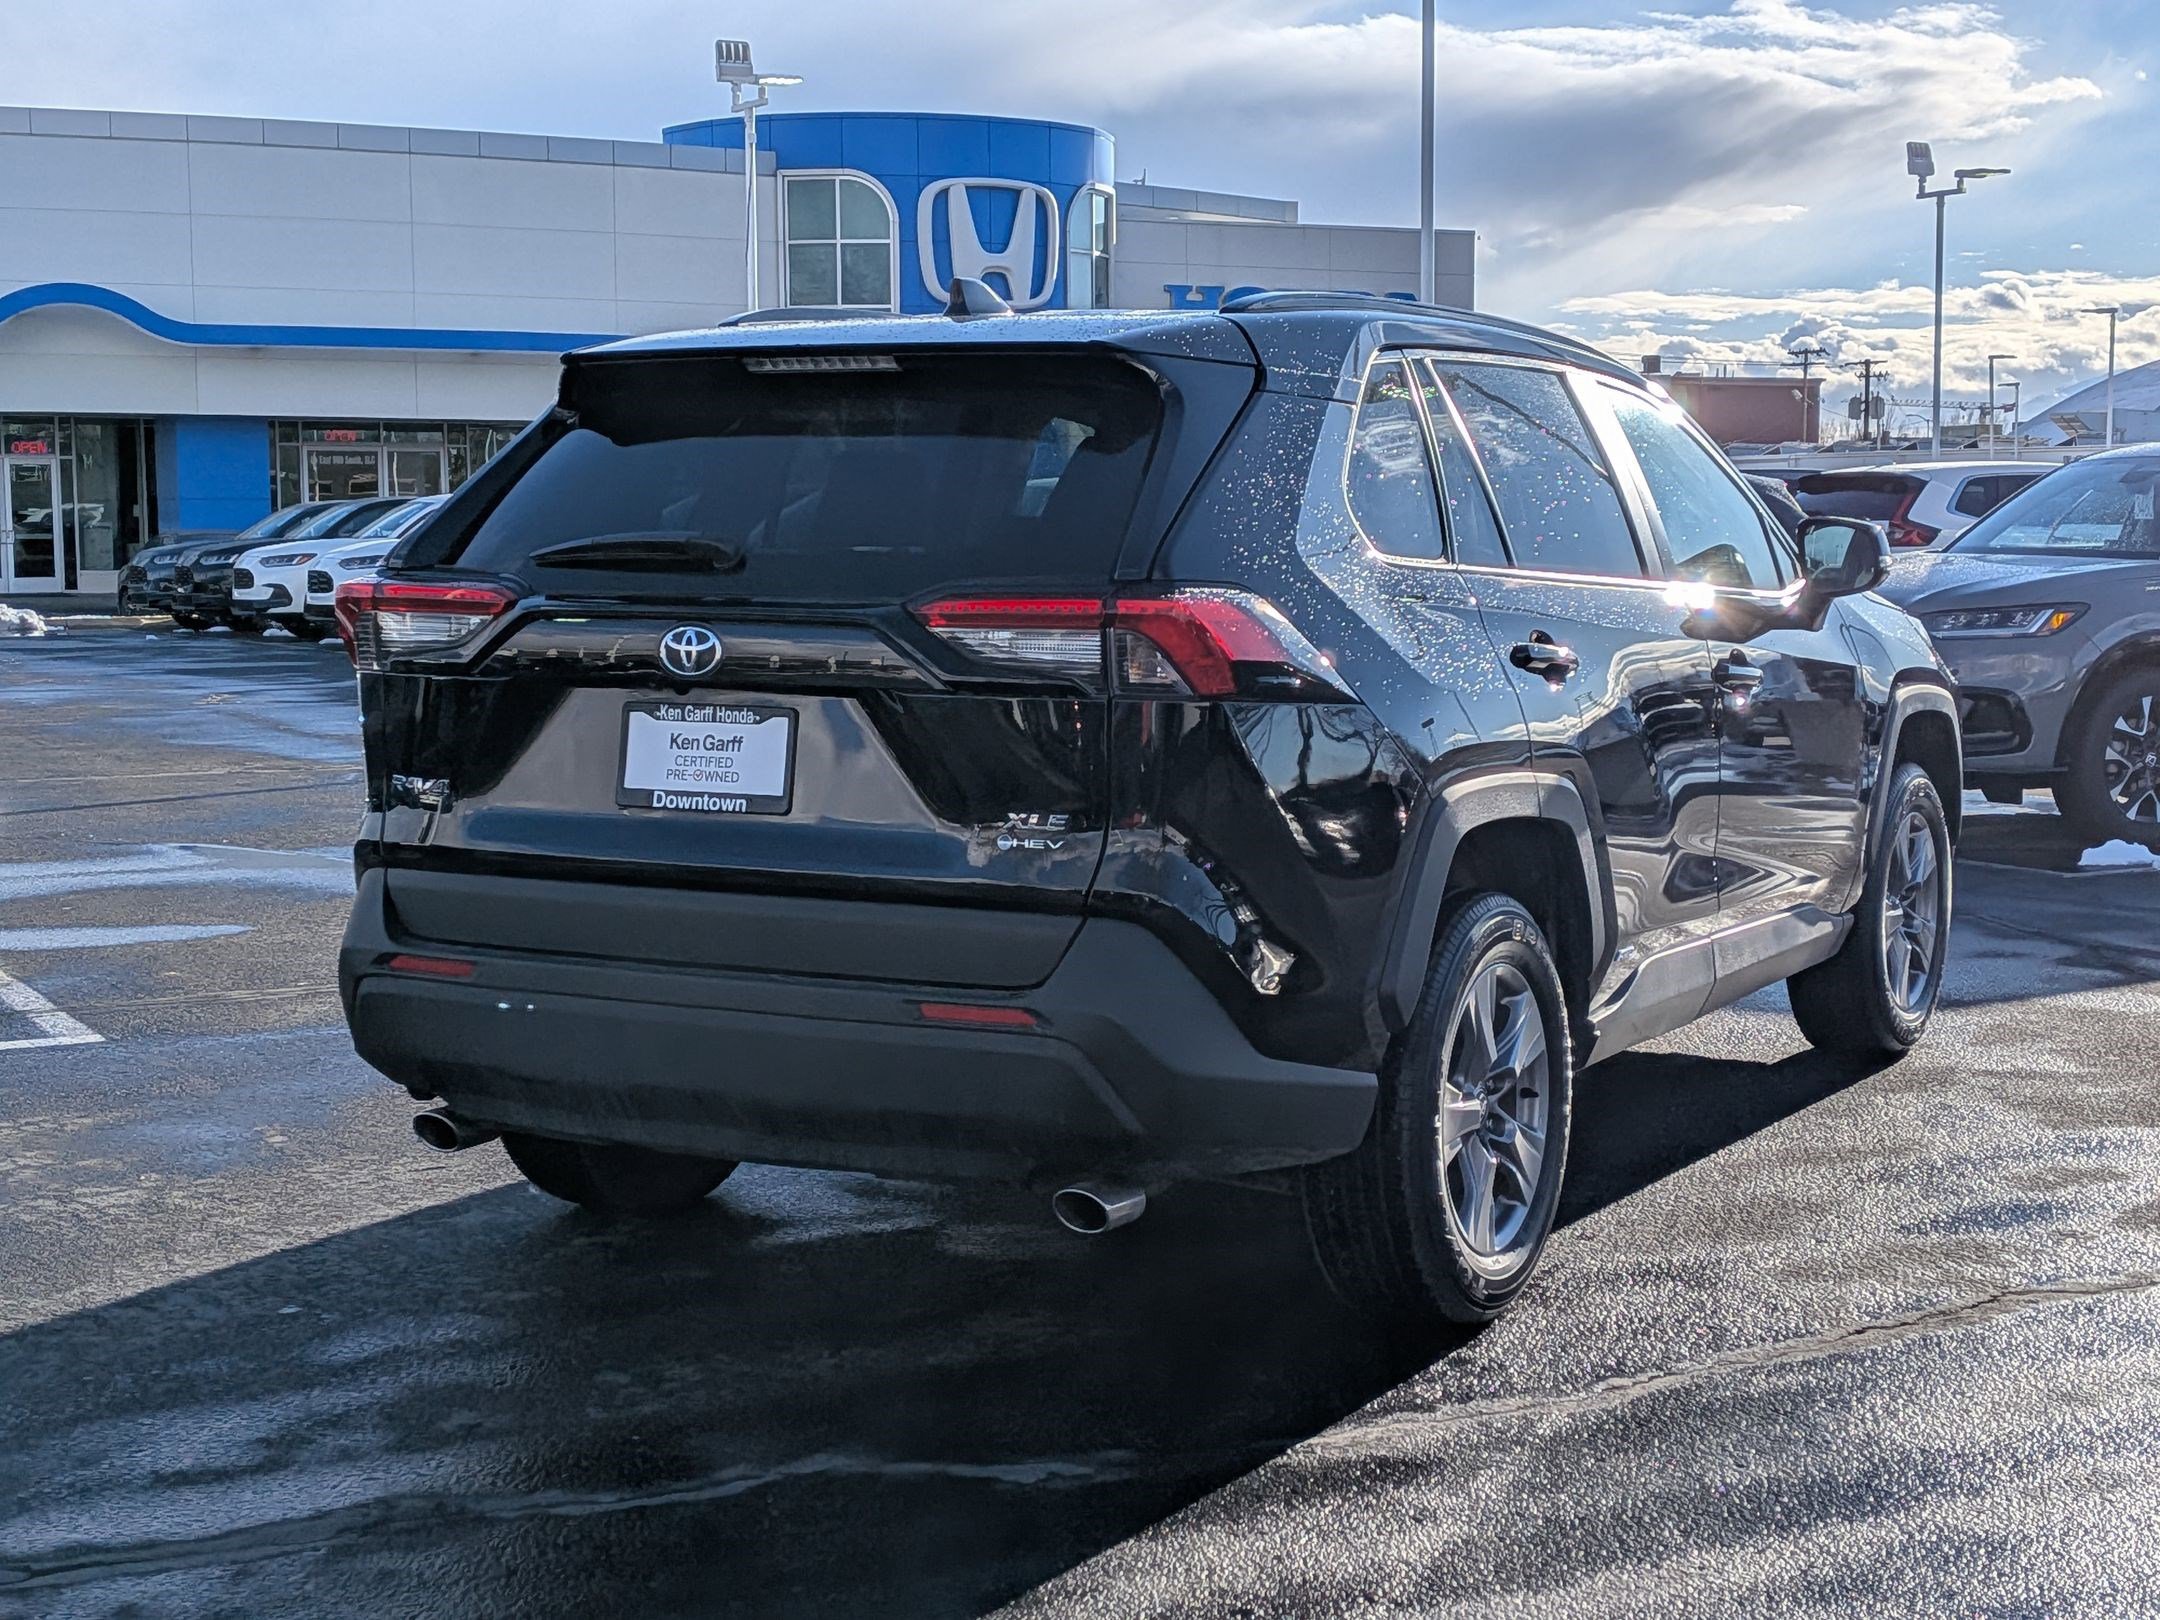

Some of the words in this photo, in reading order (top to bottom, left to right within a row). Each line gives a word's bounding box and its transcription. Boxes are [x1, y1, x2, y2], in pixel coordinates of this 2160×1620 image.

[324, 430, 357, 442] OPEN
[11, 440, 48, 454] OPEN
[658, 704, 682, 721] Ken
[684, 705, 714, 722] Garff
[716, 706, 754, 724] Honda
[669, 733, 700, 751] Ken
[702, 734, 744, 753] Garff
[674, 755, 734, 769] CERTIFIED
[666, 768, 740, 784] PRE-OWNED
[652, 791, 747, 813] Downtown
[1002, 812, 1069, 831] XLE
[1012, 838, 1066, 850] HEV
